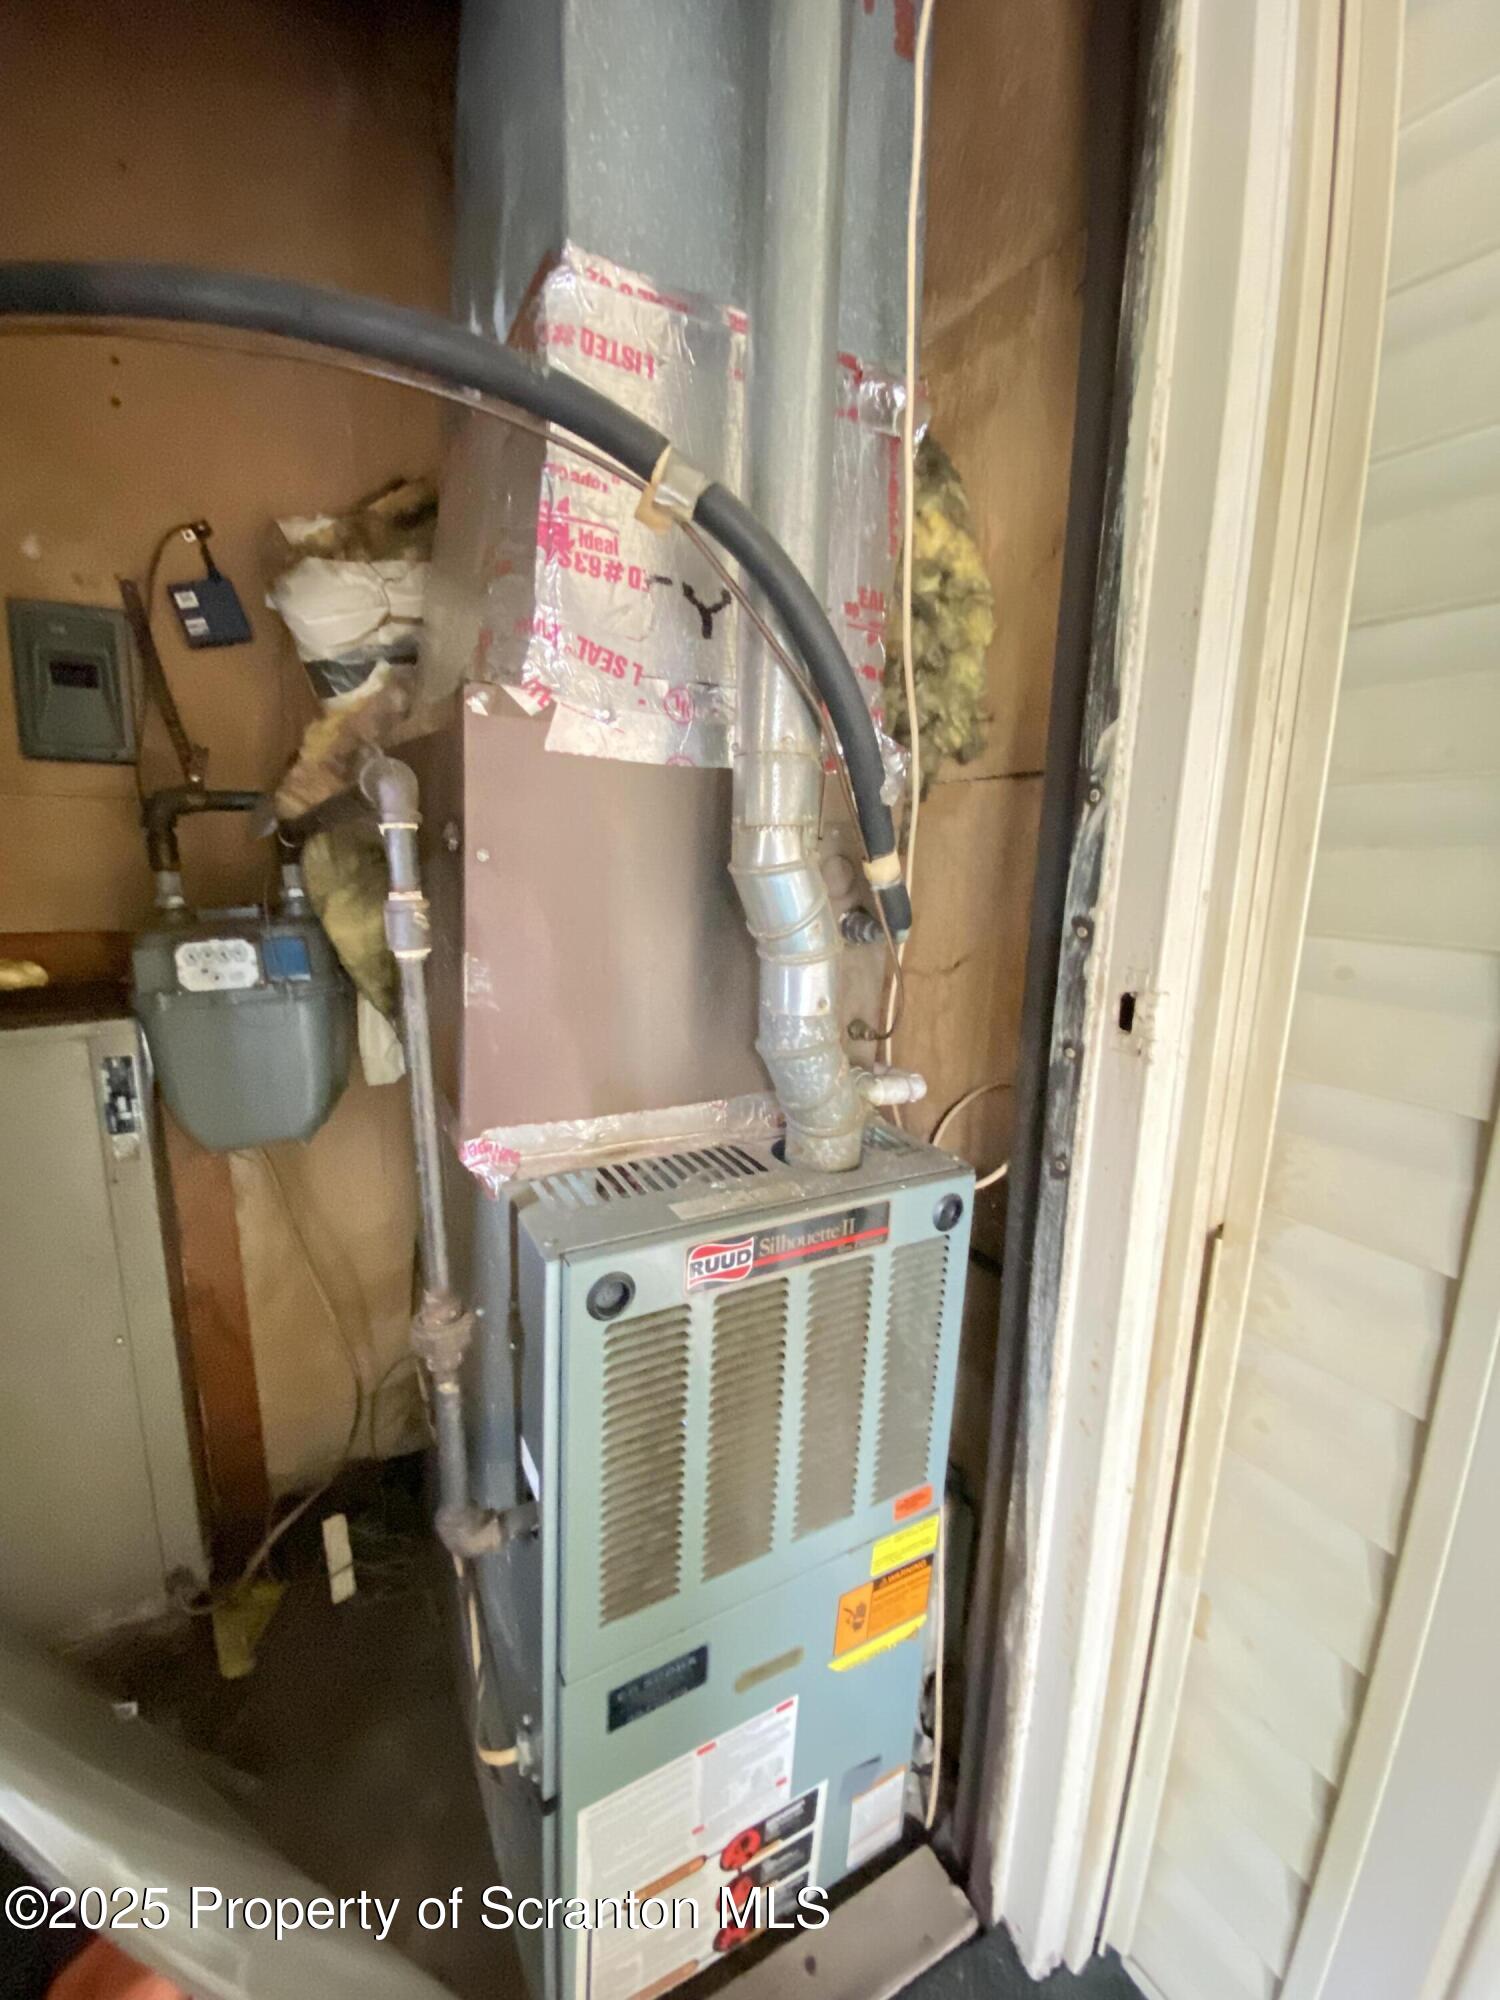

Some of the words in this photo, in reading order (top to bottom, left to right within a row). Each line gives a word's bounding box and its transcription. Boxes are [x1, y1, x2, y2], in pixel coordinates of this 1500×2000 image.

[580, 327, 656, 382] LISTED
[578, 527, 620, 556] Ideal
[576, 635, 629, 679] SEAL
[689, 1247, 752, 1279] RUUD
